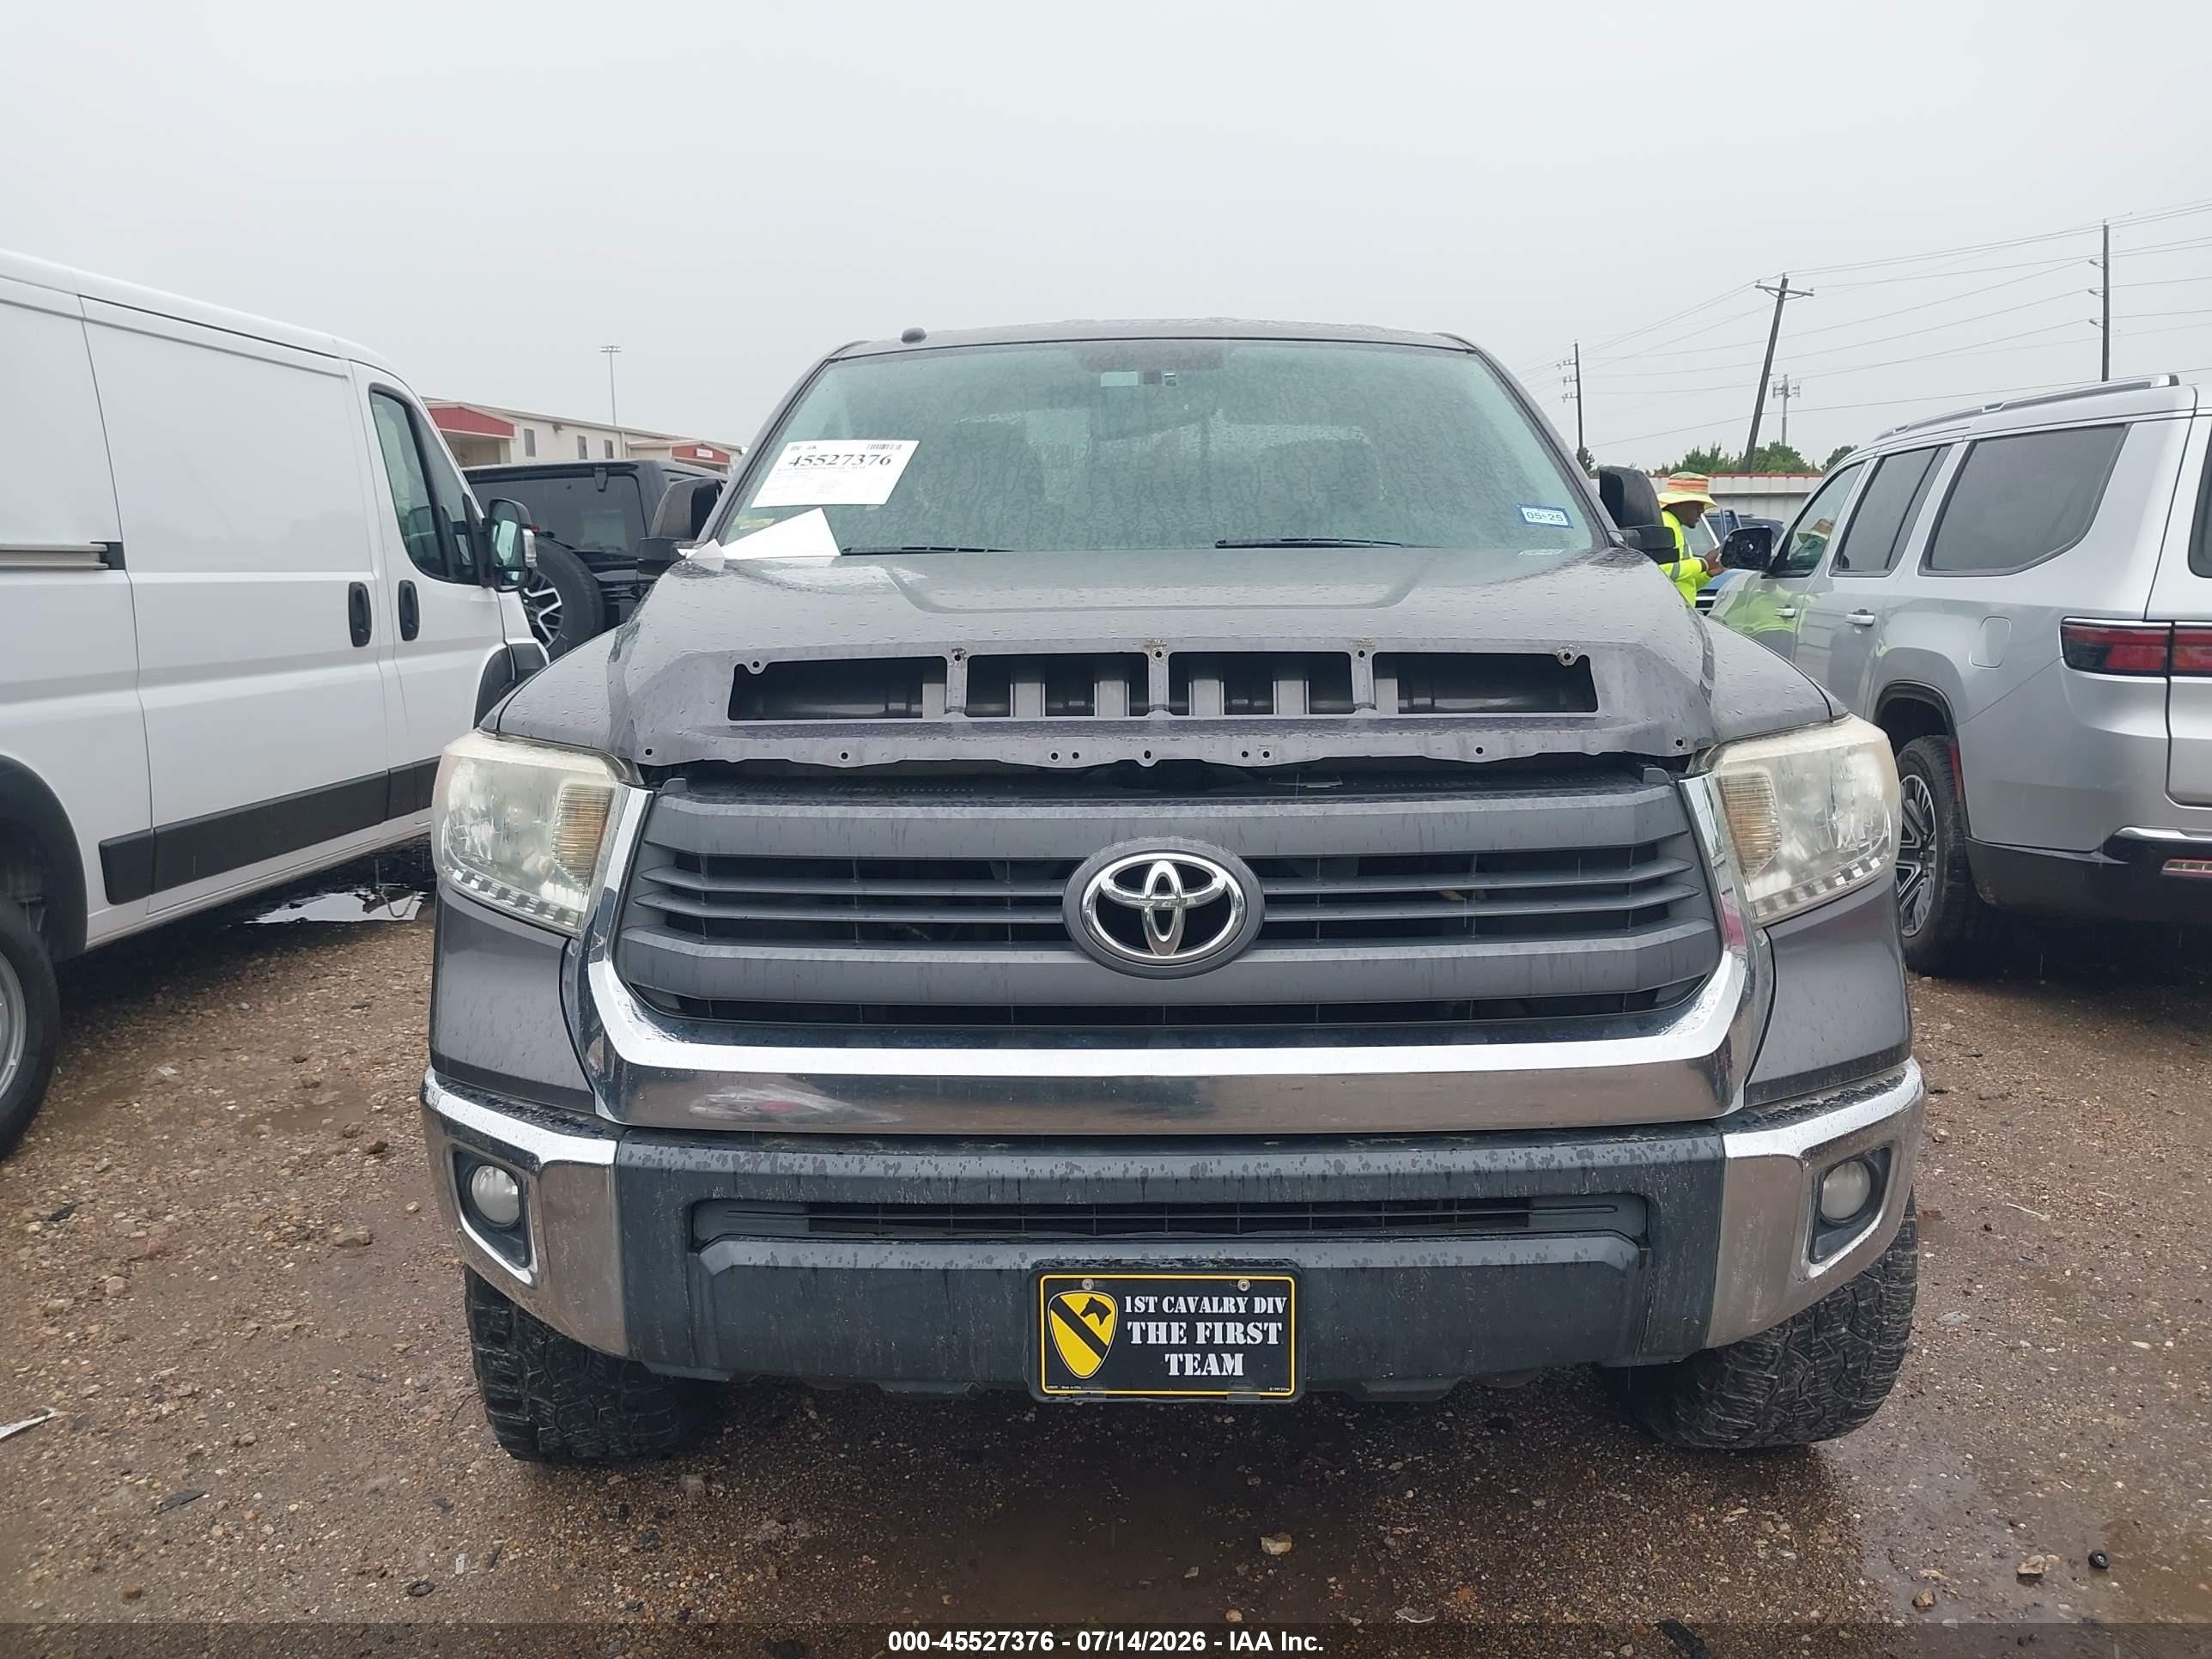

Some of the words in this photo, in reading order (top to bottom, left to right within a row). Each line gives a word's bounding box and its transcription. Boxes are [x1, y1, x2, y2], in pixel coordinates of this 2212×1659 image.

[788, 453, 893, 467] 45527376
[1125, 1296, 1158, 1313] 1ST
[1162, 1296, 1249, 1314] CAVALRY
[1254, 1297, 1287, 1314] DIV
[1127, 1321, 1187, 1345] THE
[1195, 1322, 1283, 1345] FIRST
[1164, 1352, 1244, 1376] TEAM
